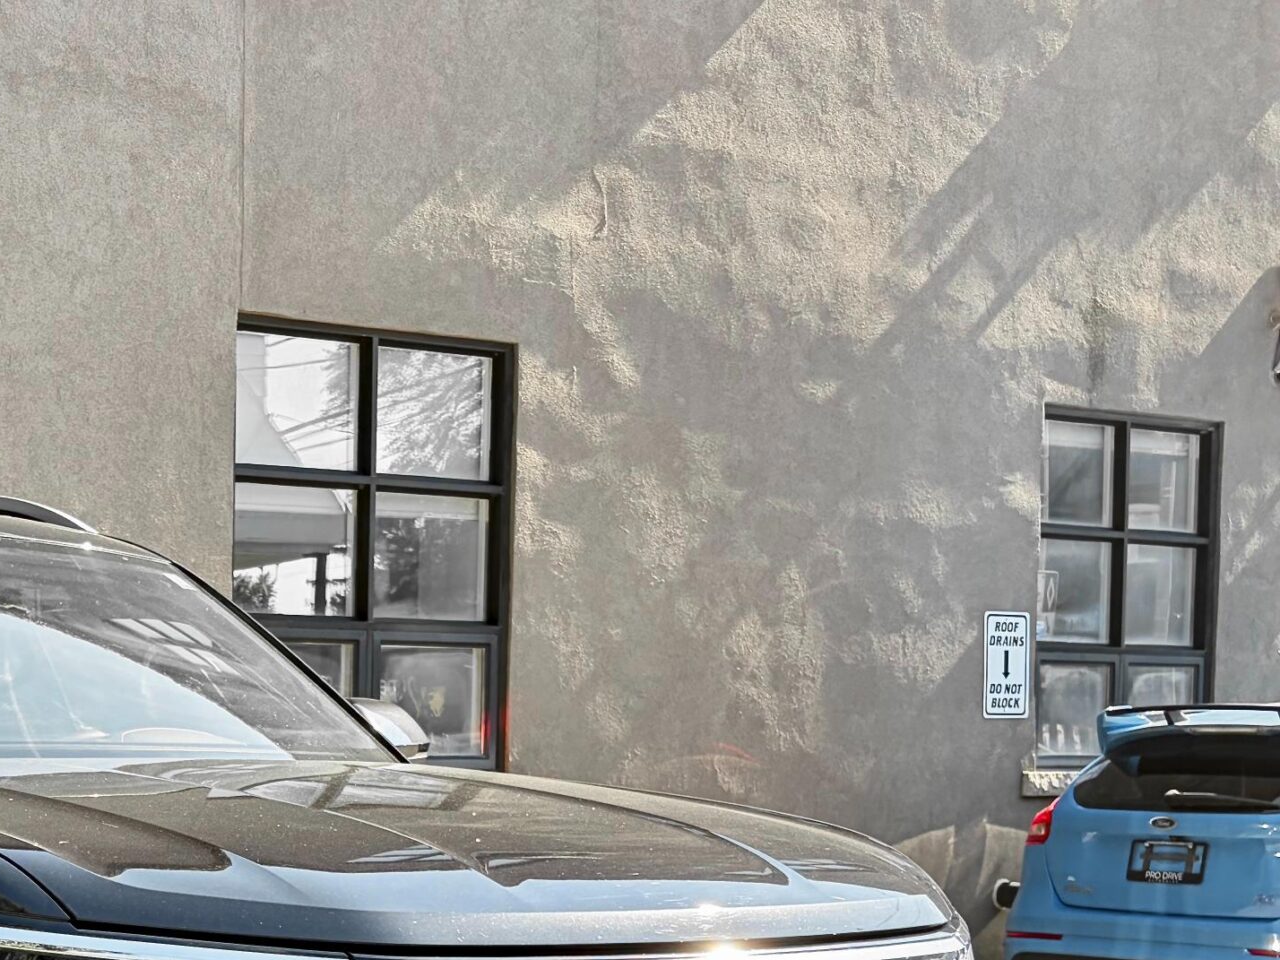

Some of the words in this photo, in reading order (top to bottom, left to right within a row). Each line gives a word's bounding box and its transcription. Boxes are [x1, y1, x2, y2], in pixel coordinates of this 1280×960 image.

[994, 621, 1020, 633] ROOF
[989, 635, 1025, 647] DRAINS
[989, 683, 1002, 694] DO
[1004, 683, 1022, 694] NOT
[991, 697, 1020, 709] BLOCK
[1145, 870, 1161, 880] PRO
[1162, 871, 1184, 881] DRIVE
